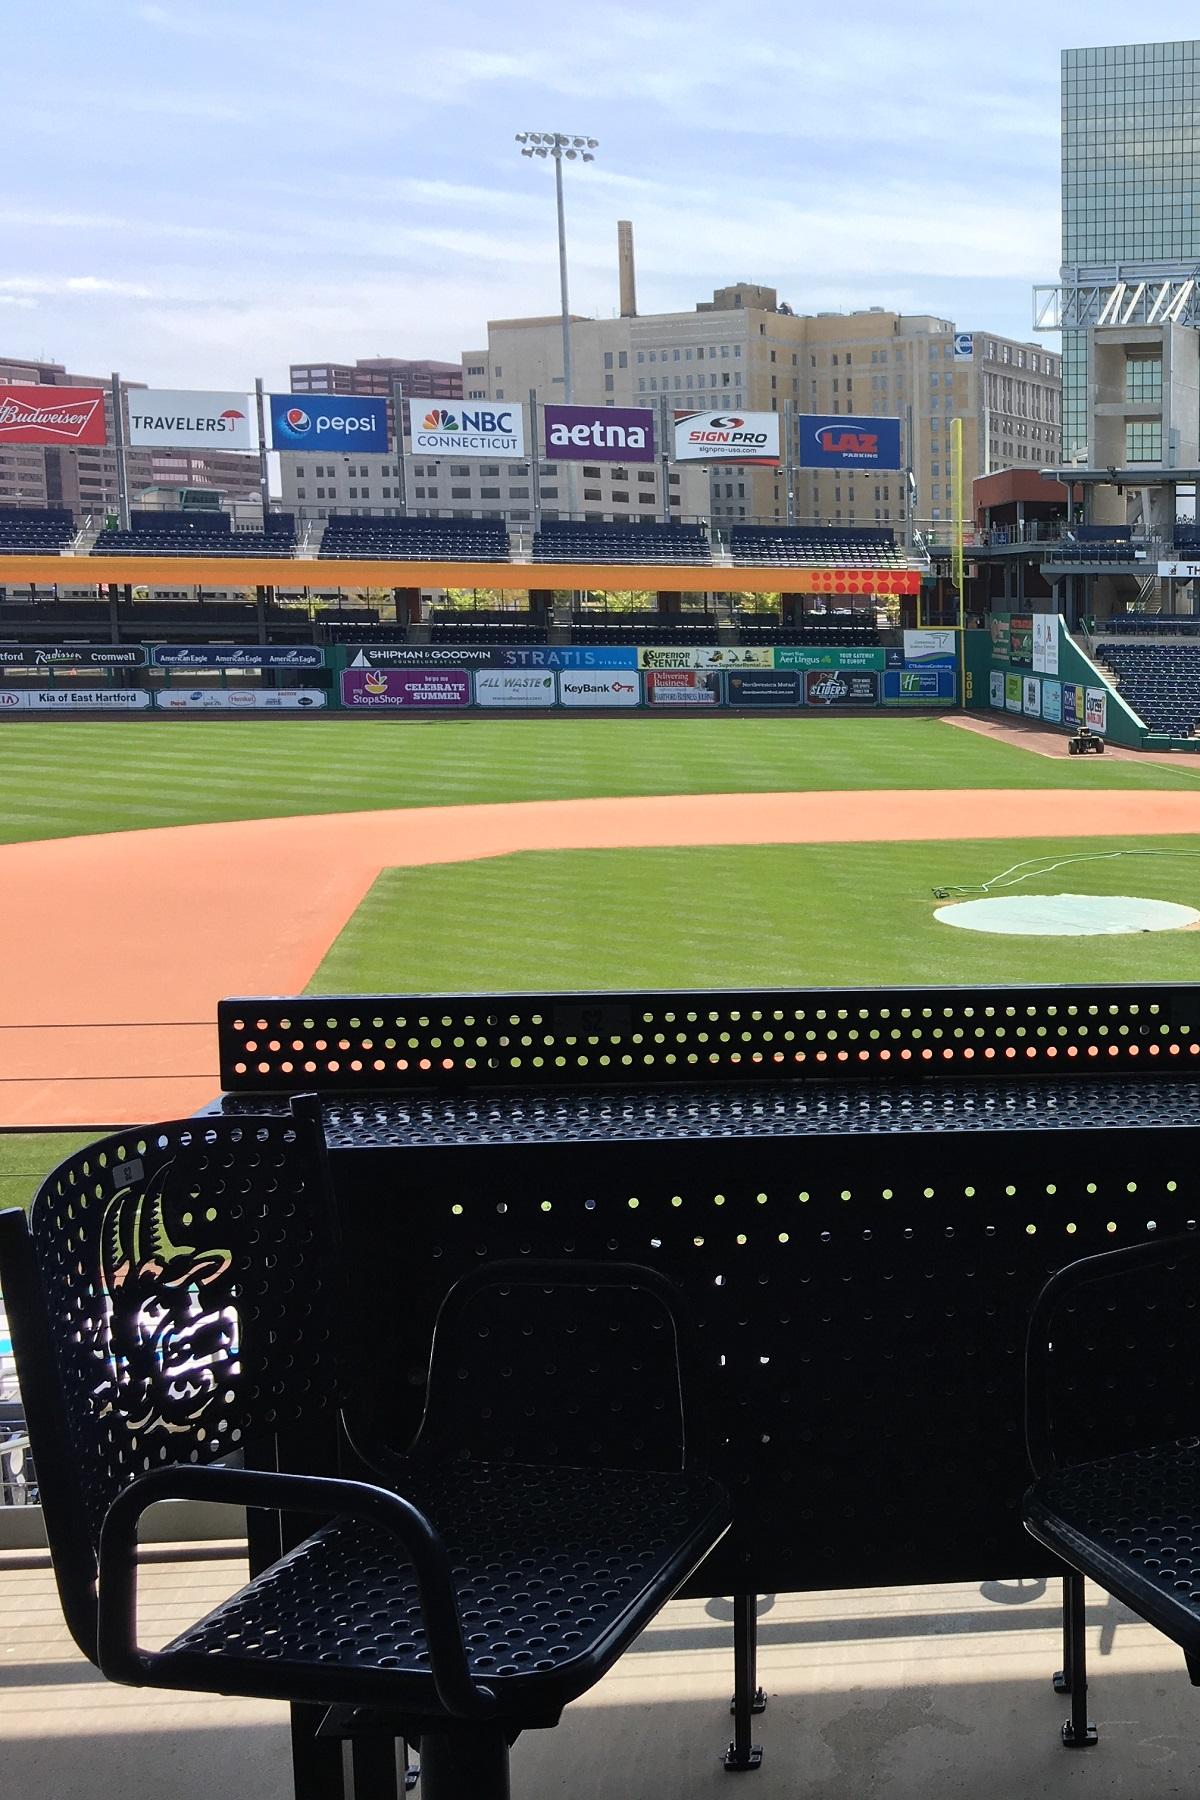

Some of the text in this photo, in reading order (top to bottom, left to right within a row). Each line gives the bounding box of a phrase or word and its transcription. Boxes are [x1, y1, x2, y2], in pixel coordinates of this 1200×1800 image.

[0, 406, 87, 424] Budweiser
[132, 416, 226, 432] TRAVELERS
[316, 414, 376, 433] pepsi
[462, 411, 512, 433] NBC
[550, 420, 646, 449] aetna
[689, 431, 767, 444] SIGN PRO
[418, 436, 517, 449] CONNECTICUT
[822, 432, 878, 453] LAZ
[699, 446, 756, 454] signpro-usa.com
[35, 649, 82, 664] Radisson
[91, 652, 136, 661] Cromwell
[191, 655, 207, 664] Eagle
[369, 651, 423, 659] SHIPMAN
[431, 651, 491, 659] GOODWIN
[504, 651, 596, 665] STRATIS
[648, 650, 690, 659] SUPERIOR
[246, 656, 262, 664] Eagle
[300, 656, 316, 664] Eagle
[651, 659, 690, 668] RENTAL
[794, 656, 820, 665] Lingus
[480, 677, 542, 688] ALL WASTE
[653, 673, 689, 682] Delivering
[405, 683, 466, 692] CELEBRATE
[564, 684, 610, 694] KeyBank
[809, 685, 847, 696] SLIDERS
[39, 693, 137, 702] Kia of East Hartford
[353, 694, 403, 706] Stop&Shop
[413, 692, 461, 700] SUMMER
